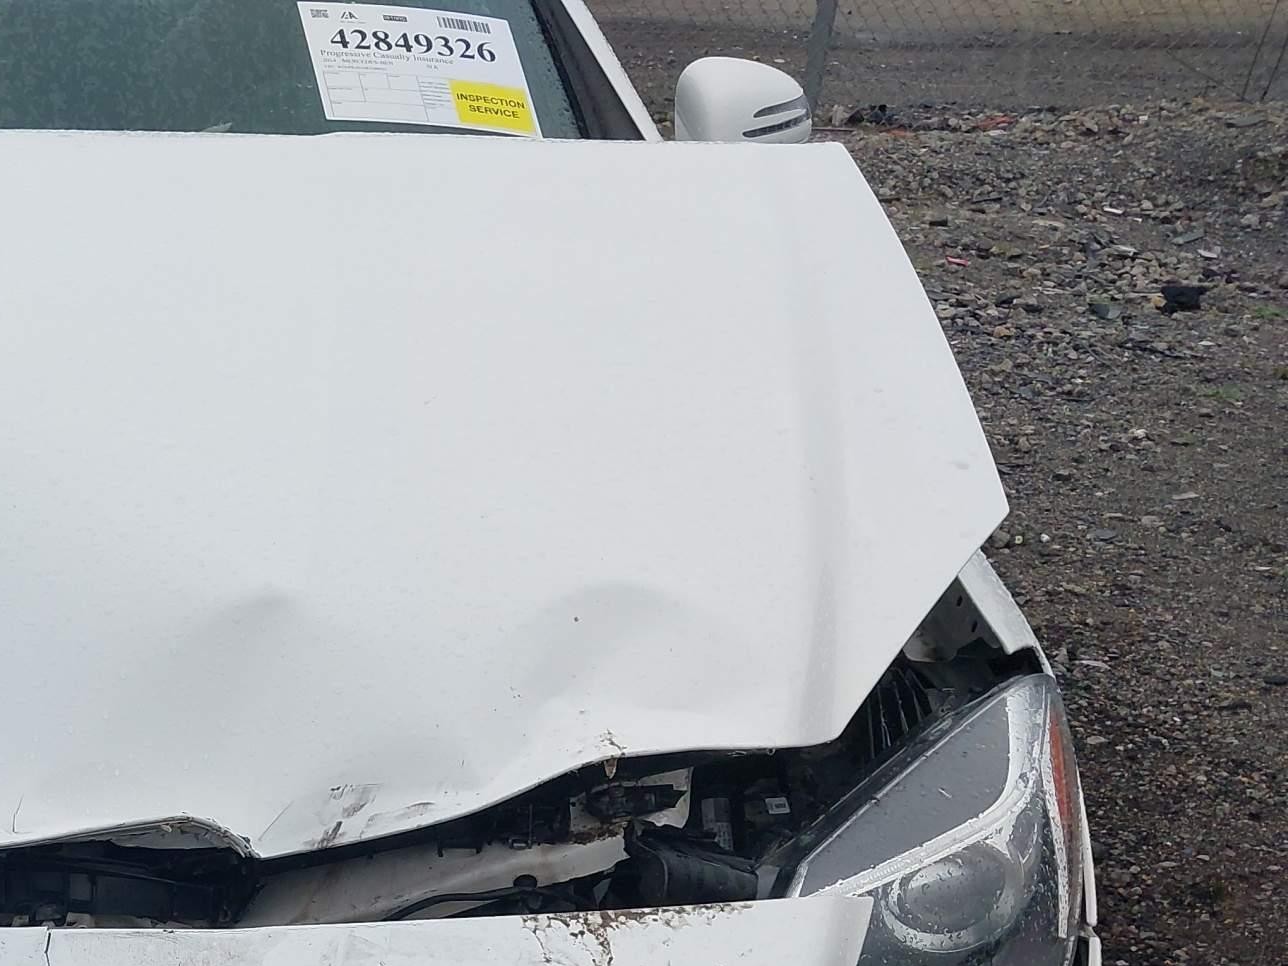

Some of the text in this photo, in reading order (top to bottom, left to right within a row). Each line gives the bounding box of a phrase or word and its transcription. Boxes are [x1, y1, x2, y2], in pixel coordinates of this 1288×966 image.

[330, 28, 496, 63] 42849326
[320, 49, 371, 60] Progressive
[373, 51, 410, 62] Casualty
[413, 54, 454, 65] Insurance
[456, 92, 526, 109] INSPECTION
[468, 104, 520, 119] SERVICE
